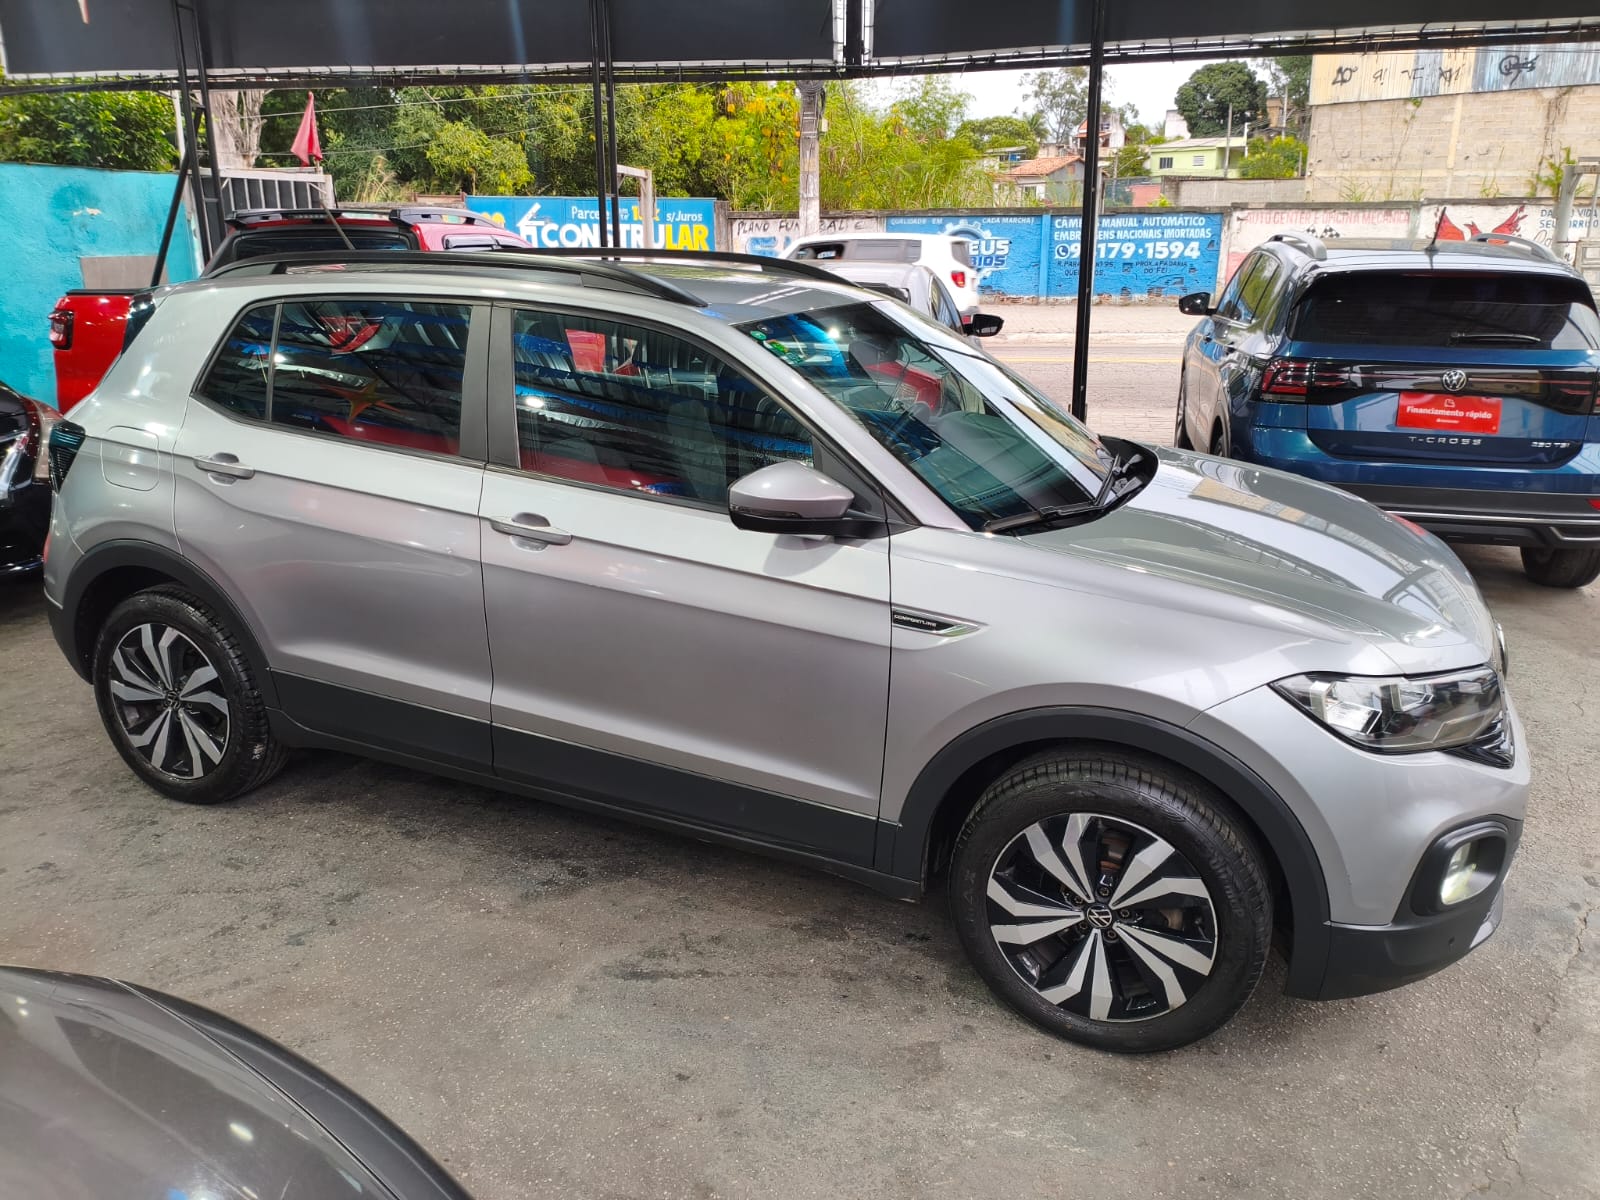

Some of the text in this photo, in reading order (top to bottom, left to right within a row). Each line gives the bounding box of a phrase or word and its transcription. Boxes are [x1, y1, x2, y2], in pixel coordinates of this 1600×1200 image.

[737, 220, 770, 235] PLANO
[1102, 217, 1138, 228] MANUAL
[1143, 214, 1205, 226] AUTOMÁTICO
[1116, 230, 1161, 240] NACIONAIS
[1164, 228, 1212, 239] IMORTADAS
[1406, 406, 1493, 420] Financiamento rápido
[1408, 436, 1482, 445] T-CROSS
